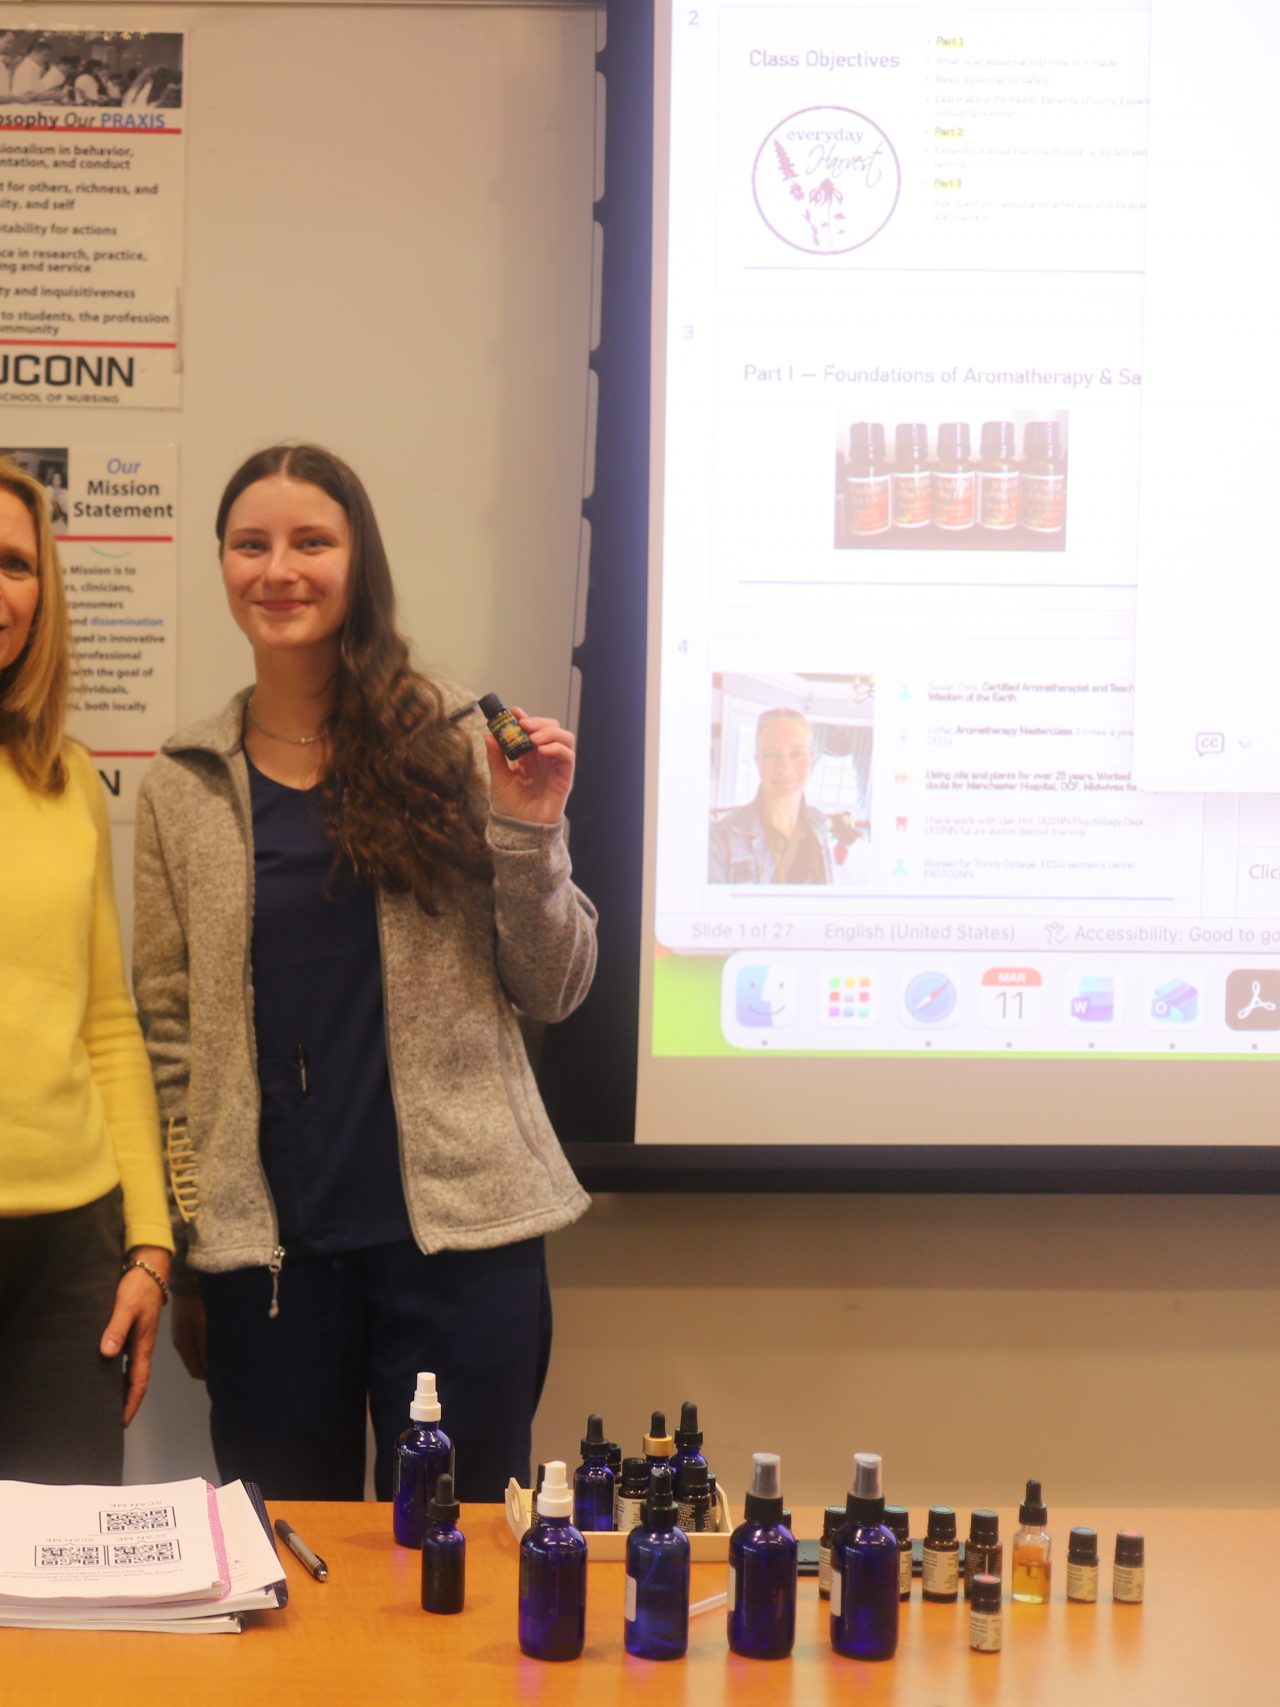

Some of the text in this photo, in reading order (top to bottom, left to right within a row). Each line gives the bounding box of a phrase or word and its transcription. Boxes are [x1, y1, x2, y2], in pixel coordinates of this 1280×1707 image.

[687, 9, 700, 27] 2
[749, 48, 901, 71] Class Objectives
[63, 112, 96, 128] Our
[100, 112, 166, 129] PRAXIS
[786, 128, 865, 145] everyday
[58, 144, 72, 155] in
[74, 145, 135, 158] behavior,
[52, 158, 76, 170] and
[79, 158, 131, 170] conduct
[804, 141, 886, 189] Harvest
[7, 180, 26, 192] for
[28, 181, 73, 195] others,
[75, 182, 131, 196] richness,
[134, 183, 158, 195] and
[25, 199, 50, 211] and
[52, 199, 75, 211] self
[50, 223, 69, 236] for
[72, 225, 118, 237] actions
[17, 247, 30, 258] in
[32, 248, 91, 261] research,
[93, 250, 148, 263] practice,
[20, 262, 44, 273] and
[47, 263, 92, 273] service
[13, 285, 38, 298] and
[40, 286, 136, 300] inquisitiveness
[1, 310, 14, 321] to
[17, 311, 76, 324] students,
[79, 312, 100, 323] the
[102, 312, 170, 325] profession
[682, 323, 695, 340] 3
[743, 364, 783, 382] Part
[823, 365, 935, 384] Foundations
[940, 366, 959, 385] of
[962, 367, 1094, 390] Aromatherapy
[1098, 368, 1113, 387] &
[46, 393, 62, 402] OF
[66, 393, 120, 404] NURSING
[107, 457, 142, 476] Our
[87, 479, 160, 497] Mission
[73, 501, 174, 518] Statement
[70, 565, 111, 577] Mission
[113, 565, 123, 576] is
[125, 566, 137, 576] to
[80, 582, 135, 594] clinicians,
[90, 617, 165, 627] dissemination
[97, 633, 108, 643] in
[109, 633, 166, 644] innovative
[96, 667, 115, 677] the
[117, 667, 140, 679] goal
[142, 667, 154, 677] of
[85, 701, 110, 711] both
[112, 702, 147, 714] locally
[691, 922, 733, 938] Slide
[750, 922, 768, 938] of
[773, 922, 794, 938] 27
[824, 922, 1016, 944] English (United States)
[1075, 925, 1280, 946] Accessibility: Good to go
[998, 971, 1027, 984] MAR
[995, 990, 1024, 1021] 11
[1072, 1001, 1089, 1015] W
